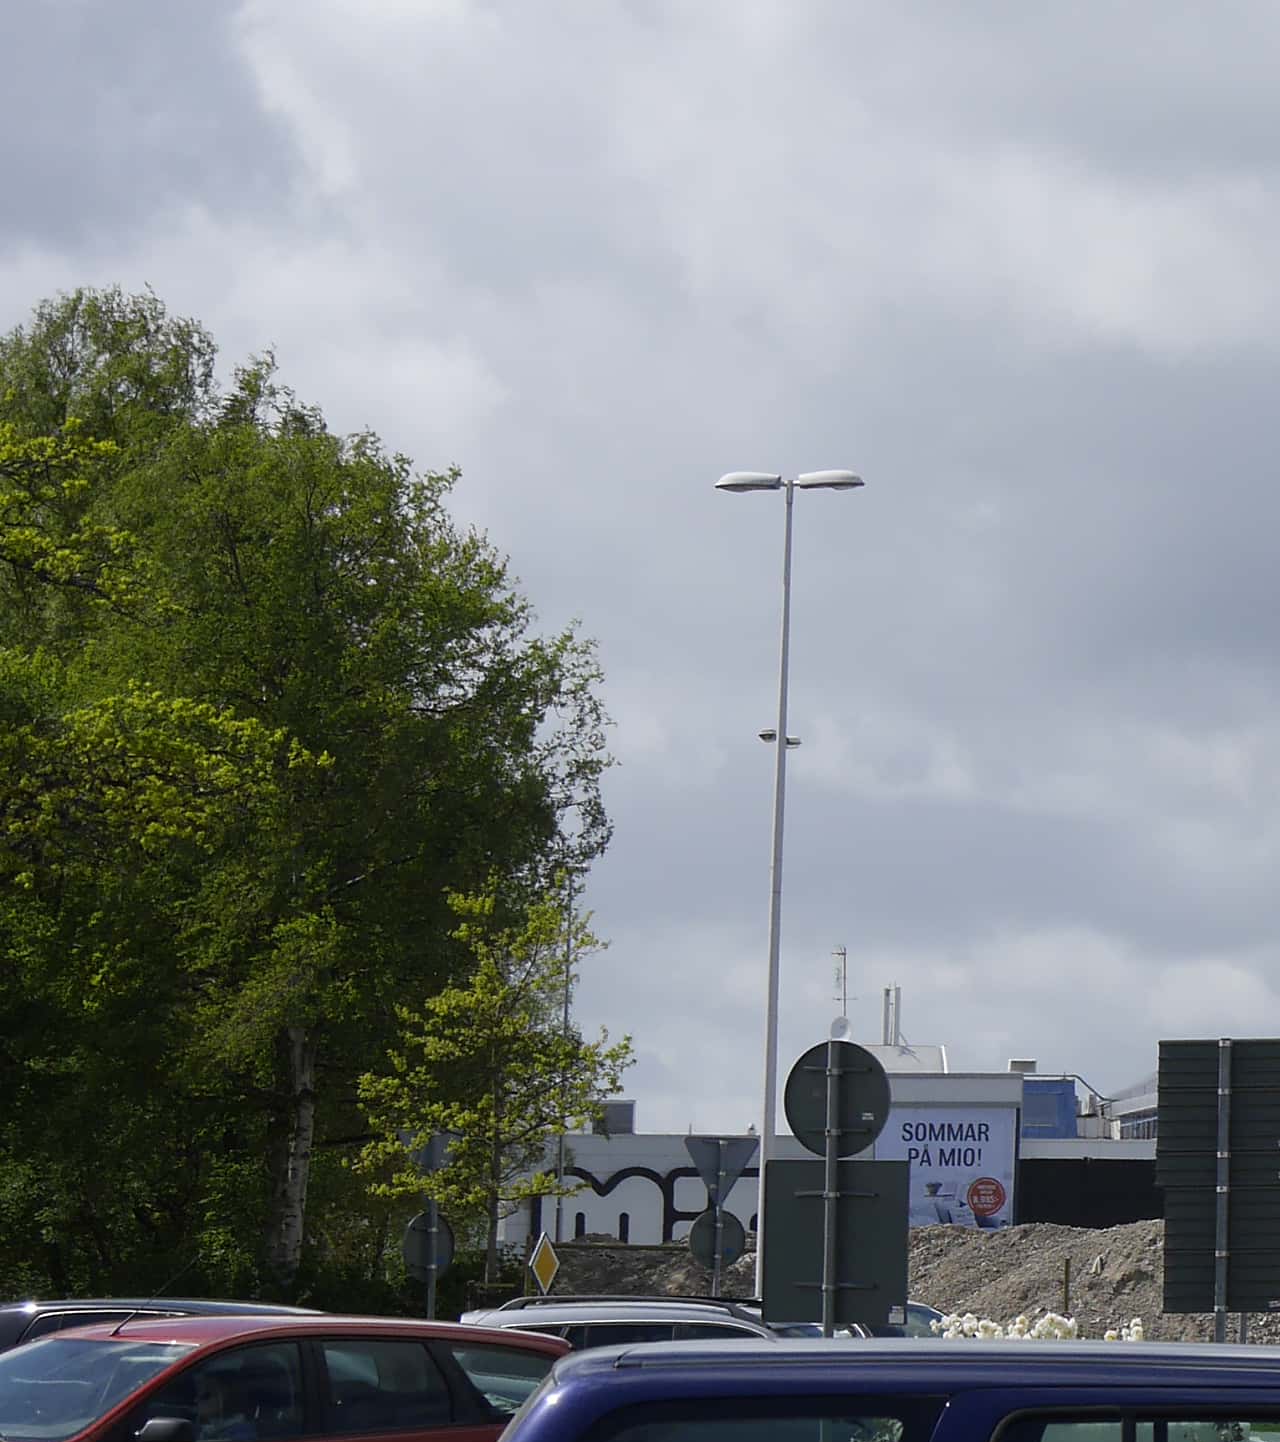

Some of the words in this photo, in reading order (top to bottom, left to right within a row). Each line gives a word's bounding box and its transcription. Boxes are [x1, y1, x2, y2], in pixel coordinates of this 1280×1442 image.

[902, 1122, 989, 1142] SOMMAR
[908, 1144, 932, 1167] PÅ
[939, 1147, 982, 1167] MIO!
